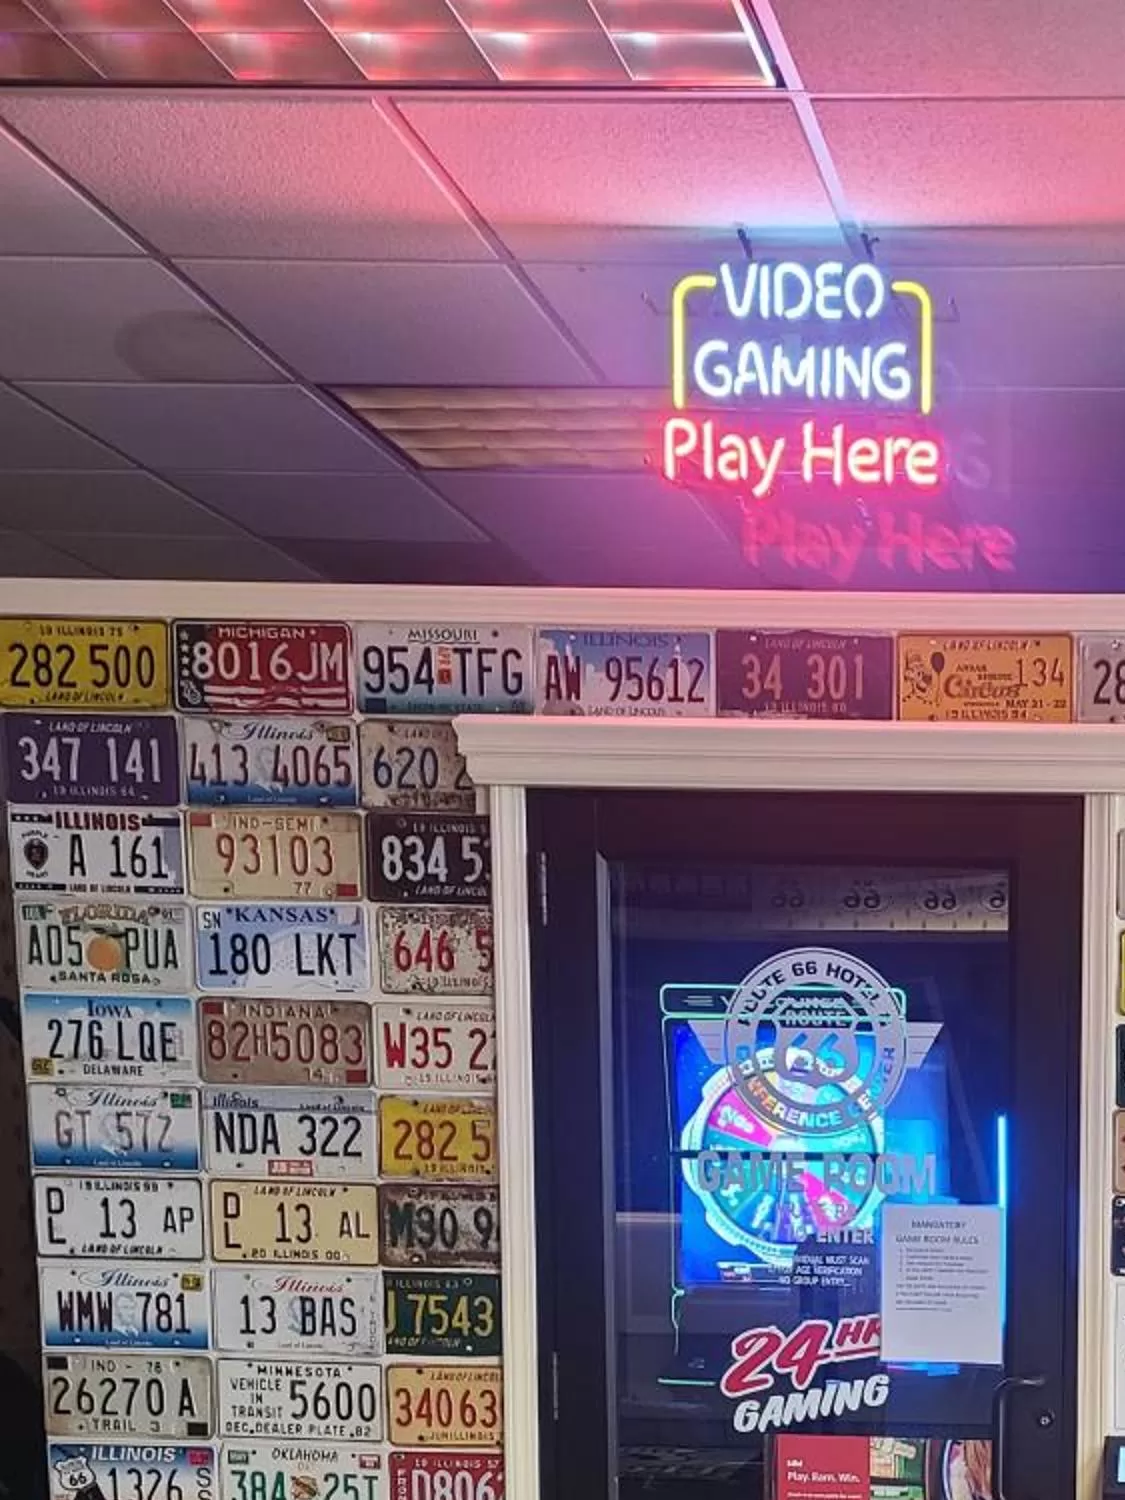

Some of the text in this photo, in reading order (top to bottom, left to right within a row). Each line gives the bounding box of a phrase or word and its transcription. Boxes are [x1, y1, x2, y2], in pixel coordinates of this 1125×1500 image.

[719, 261, 884, 320] VIDEO
[694, 340, 911, 400] GAMING
[664, 418, 938, 498] Play Here
[219, 626, 305, 639] MICHIGAN
[408, 628, 479, 641] MISSOURI
[583, 634, 670, 648] ILLINOIS
[10, 643, 156, 689] 282 500
[363, 647, 523, 697] 954 TFG
[241, 720, 314, 742] Illinois
[18, 737, 162, 783] 347 141
[55, 812, 141, 830] ILLINOIS
[217, 834, 333, 877] 93103
[235, 908, 328, 923] KANSAS
[125, 929, 179, 969] PUA
[209, 933, 357, 976] 180 LKT
[792, 961, 817, 976] 66
[59, 972, 149, 984] SANTA ROSA
[243, 1003, 326, 1018] INDIANA
[48, 1020, 176, 1062] 276 LQE
[209, 1021, 364, 1064] 82H5083
[83, 1065, 143, 1077] DELAWARE
[215, 1114, 362, 1157] NDA 322
[700, 1153, 936, 1196] GAME ROOM
[100, 1199, 194, 1238] 13 AP
[817, 1228, 874, 1245] ENTER
[256, 1364, 342, 1378] MINNESOTA
[721, 1320, 833, 1397] 24
[231, 1379, 281, 1391] VEHICLE
[290, 1381, 375, 1422] 5600
[733, 1374, 890, 1432] GAMING
[231, 1405, 283, 1419] TRANSIT
[257, 1423, 345, 1436] DEALER PLATE
[92, 1447, 175, 1462] ILLINOIS
